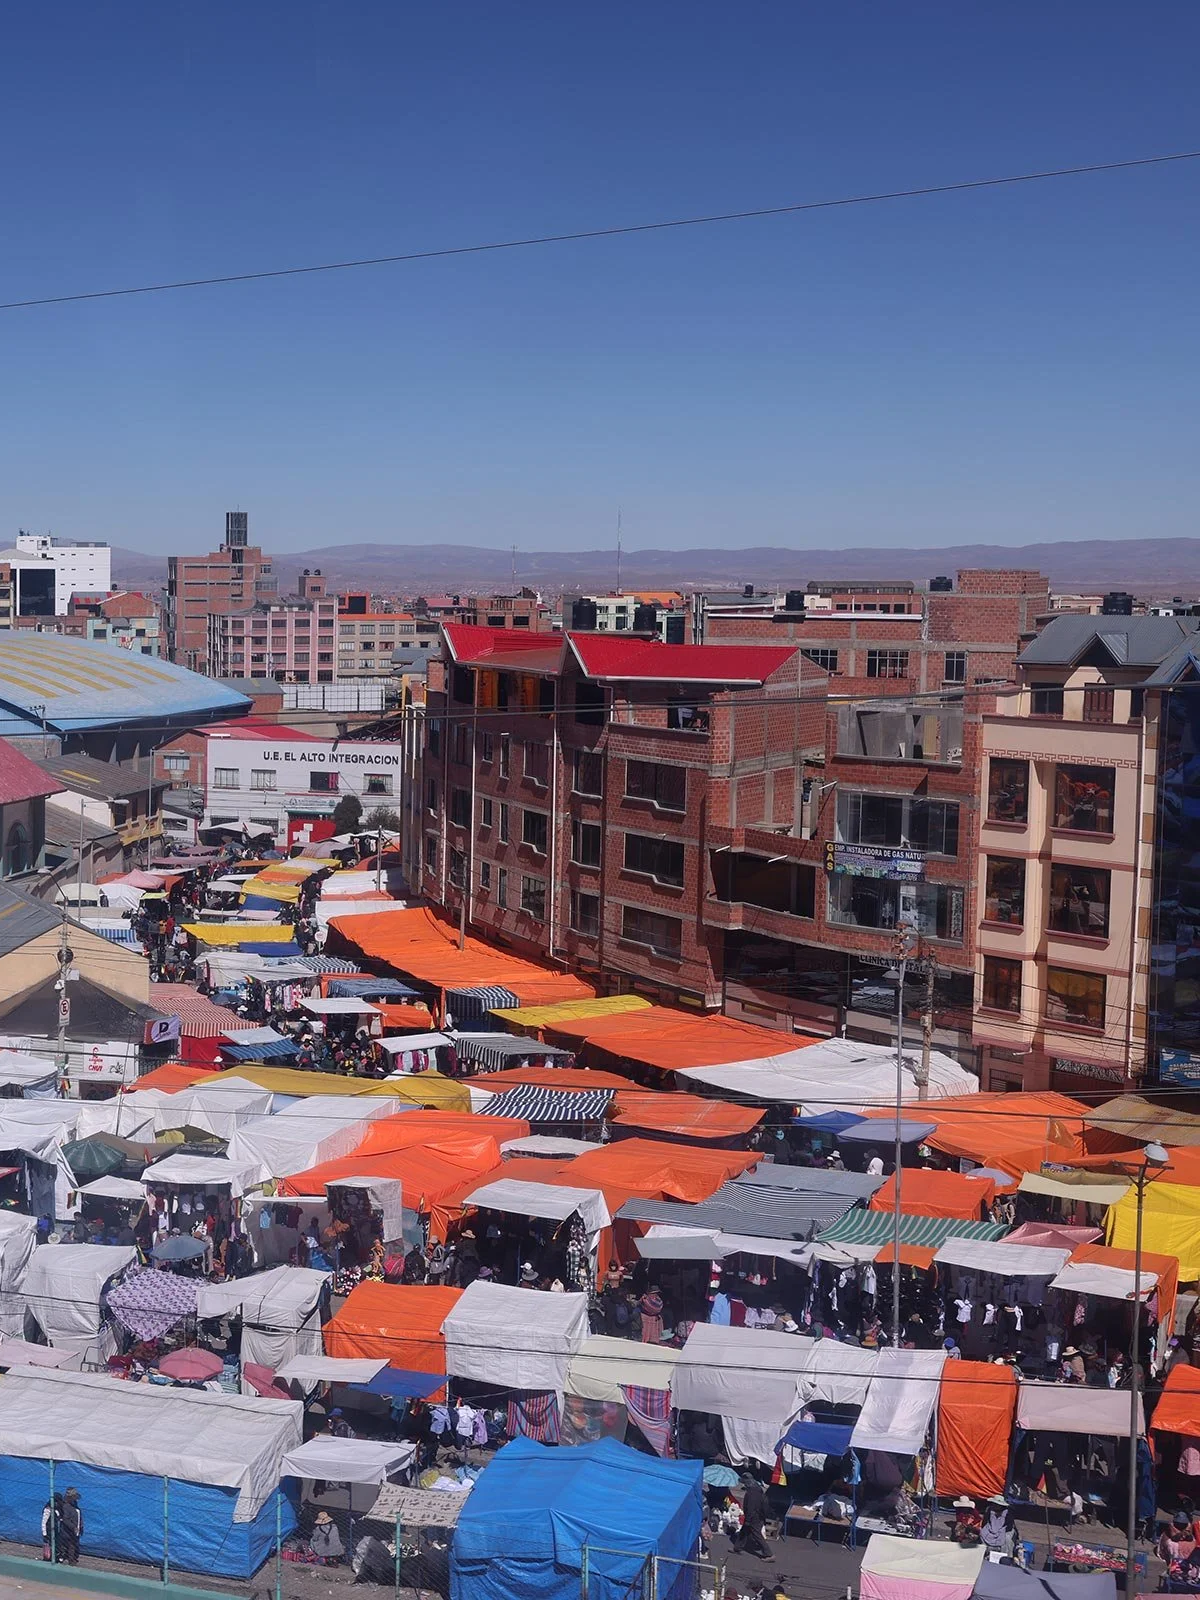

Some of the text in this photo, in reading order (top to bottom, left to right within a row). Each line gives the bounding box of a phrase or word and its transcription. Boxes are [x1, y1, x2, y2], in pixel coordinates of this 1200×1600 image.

[263, 751, 399, 765] U.E. EL ALTO INTEGRACION
[826, 843, 834, 871] GAS
[847, 846, 883, 857] INSTALADORA
[883, 850, 891, 858] DE
[892, 850, 904, 859] GAS
